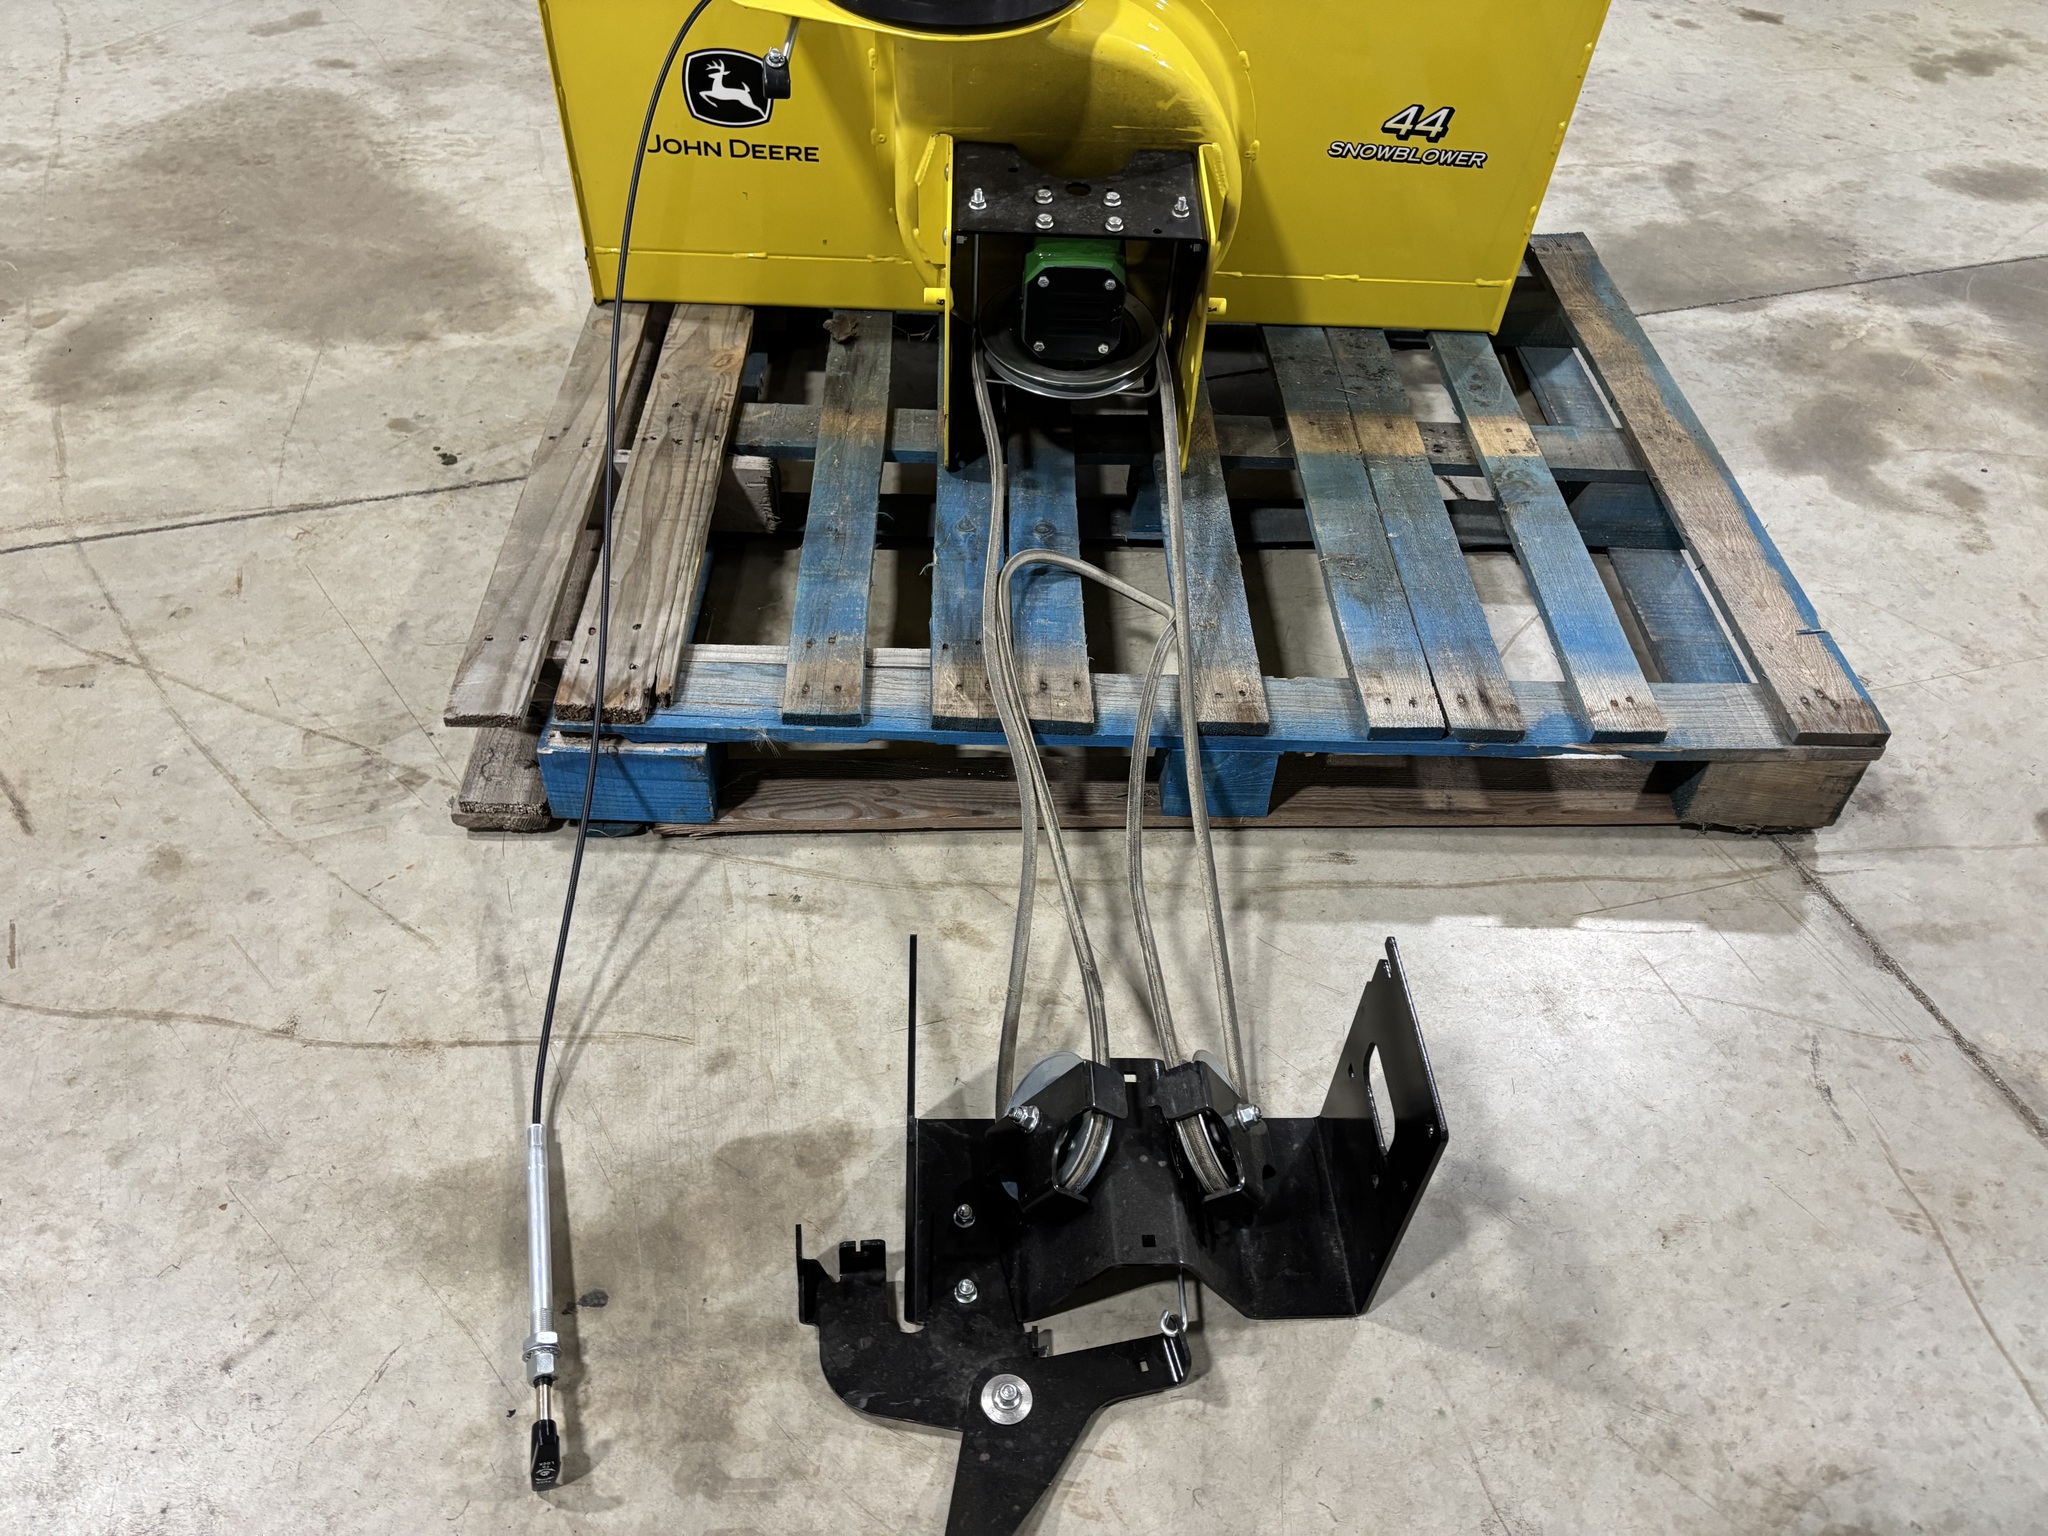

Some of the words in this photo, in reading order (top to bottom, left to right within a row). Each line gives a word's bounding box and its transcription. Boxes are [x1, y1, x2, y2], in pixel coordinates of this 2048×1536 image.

[1381, 104, 1455, 143] 44
[647, 134, 722, 157] JOHN
[729, 139, 819, 162] DEERE
[1327, 141, 1488, 169] SNOWBLOWER
